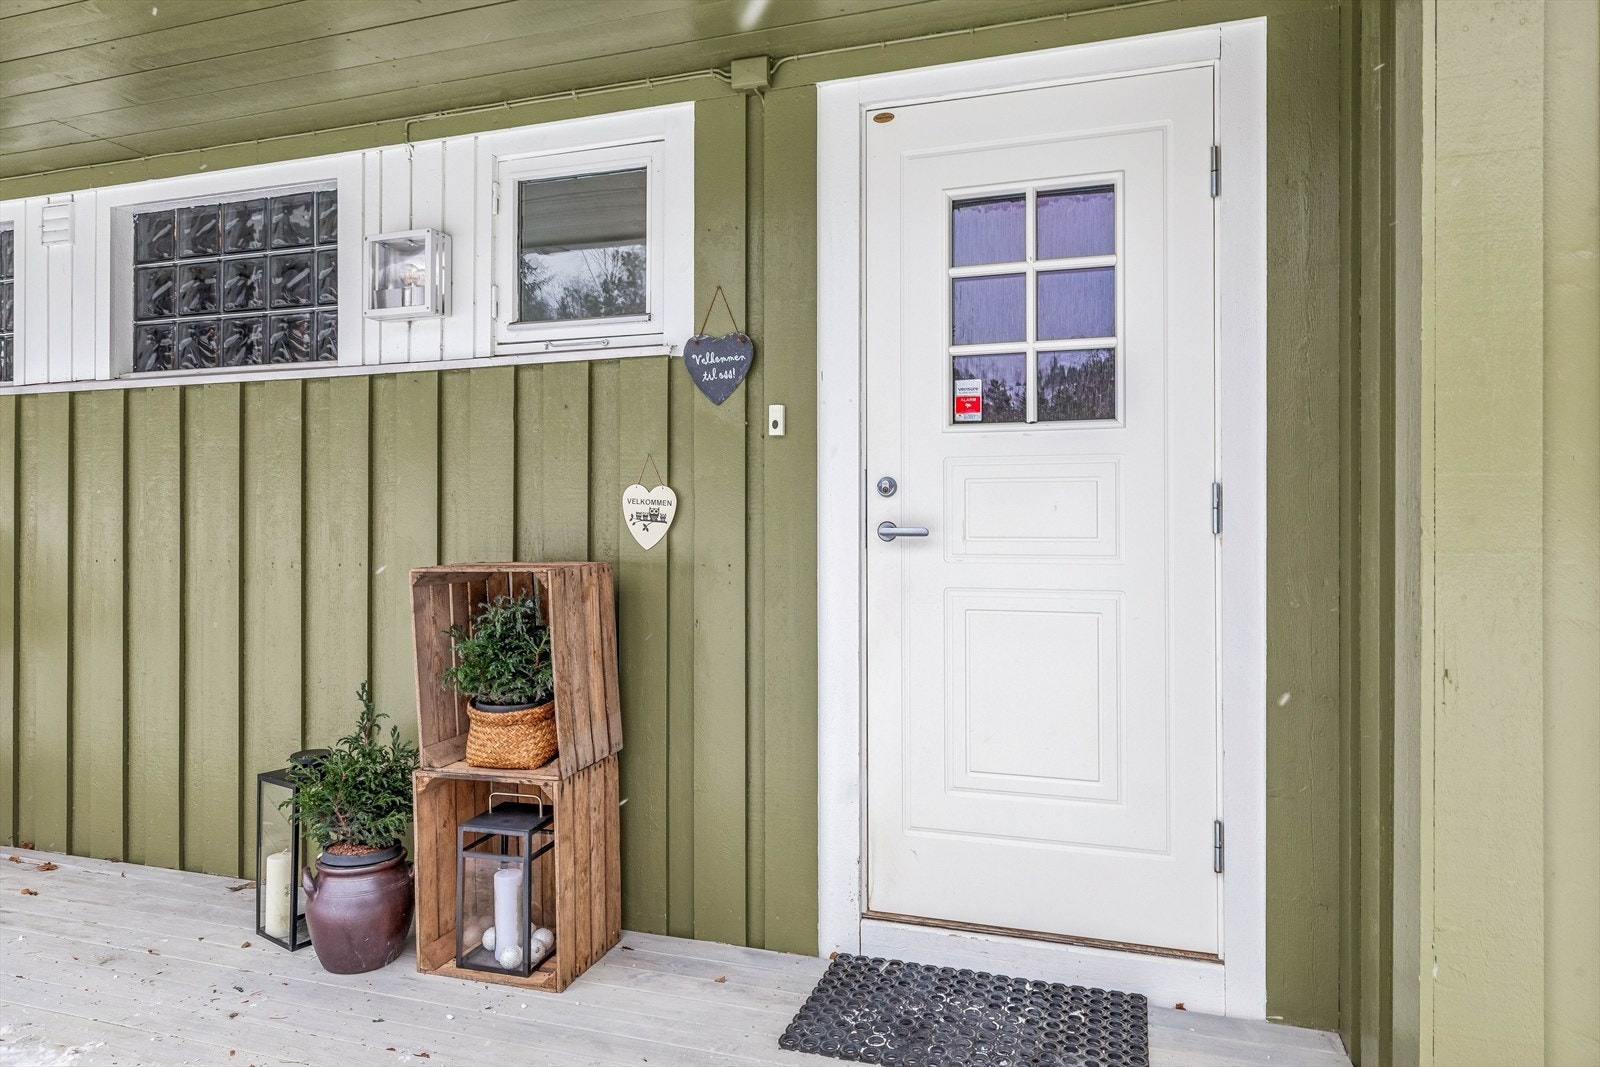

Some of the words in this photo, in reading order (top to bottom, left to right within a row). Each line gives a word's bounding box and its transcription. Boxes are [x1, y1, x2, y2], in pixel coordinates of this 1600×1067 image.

[691, 351, 746, 366] Velkommen
[702, 367, 717, 382] til
[718, 367, 736, 380] oss!
[626, 497, 673, 507] VELKOMMEN
